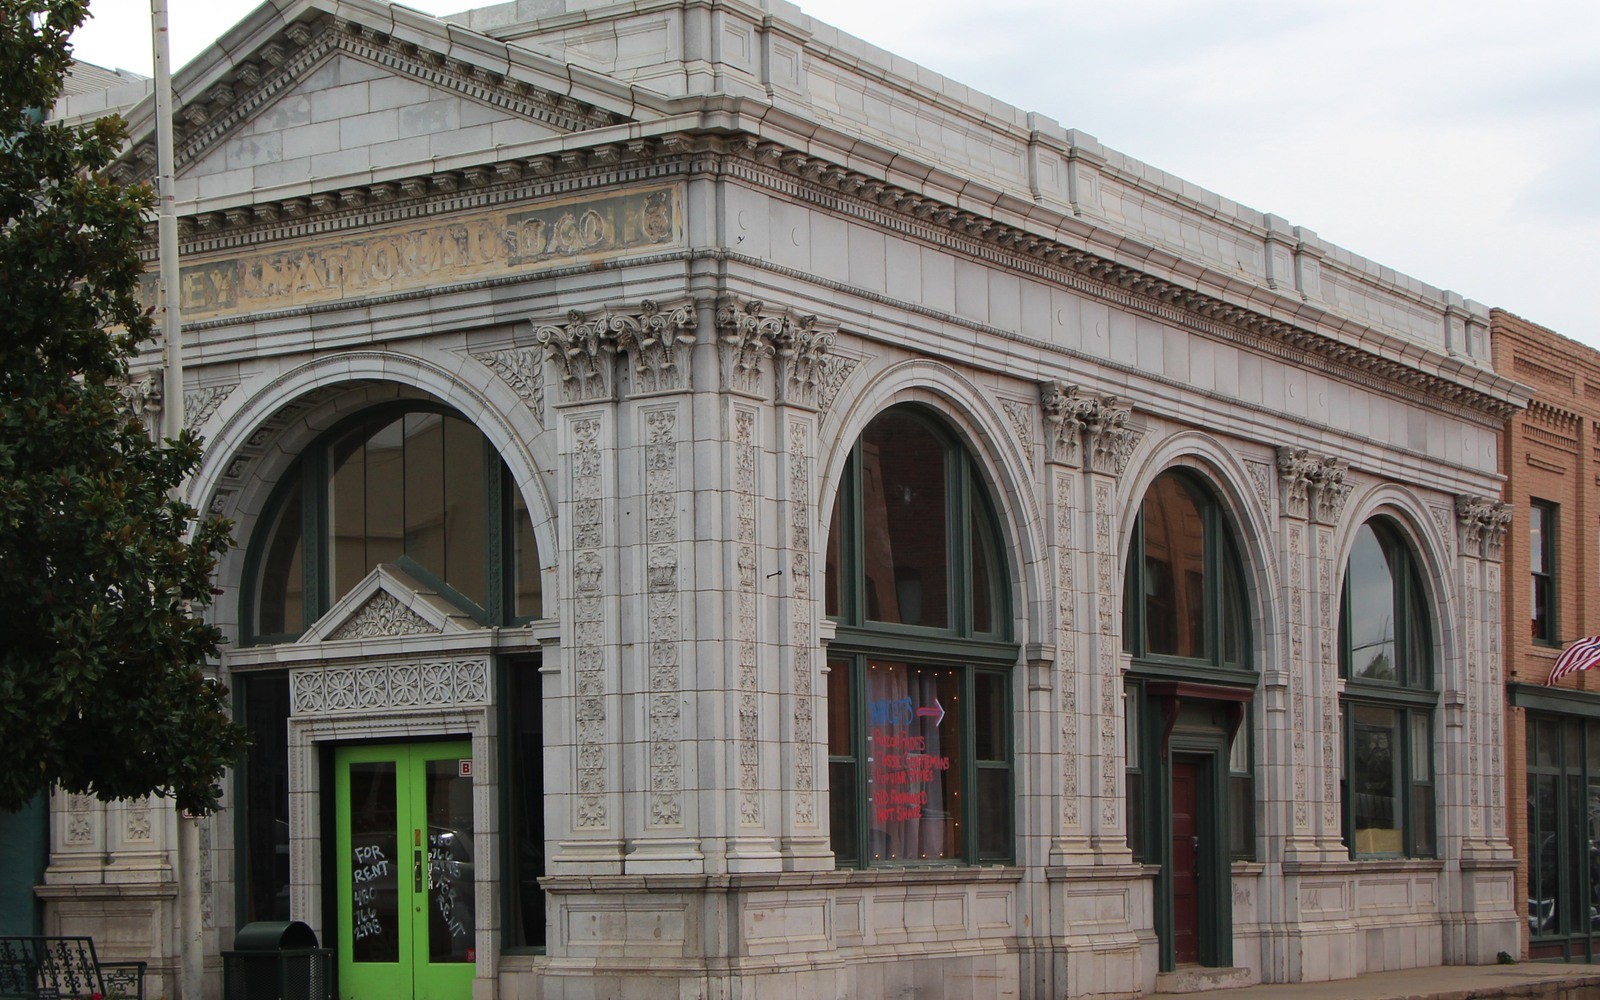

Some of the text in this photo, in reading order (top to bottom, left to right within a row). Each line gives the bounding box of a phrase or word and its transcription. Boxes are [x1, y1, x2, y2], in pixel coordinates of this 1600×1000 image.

[462, 763, 470, 774] B
[354, 845, 385, 864] FOR
[354, 860, 389, 883] RENT
[354, 887, 377, 906] 480
